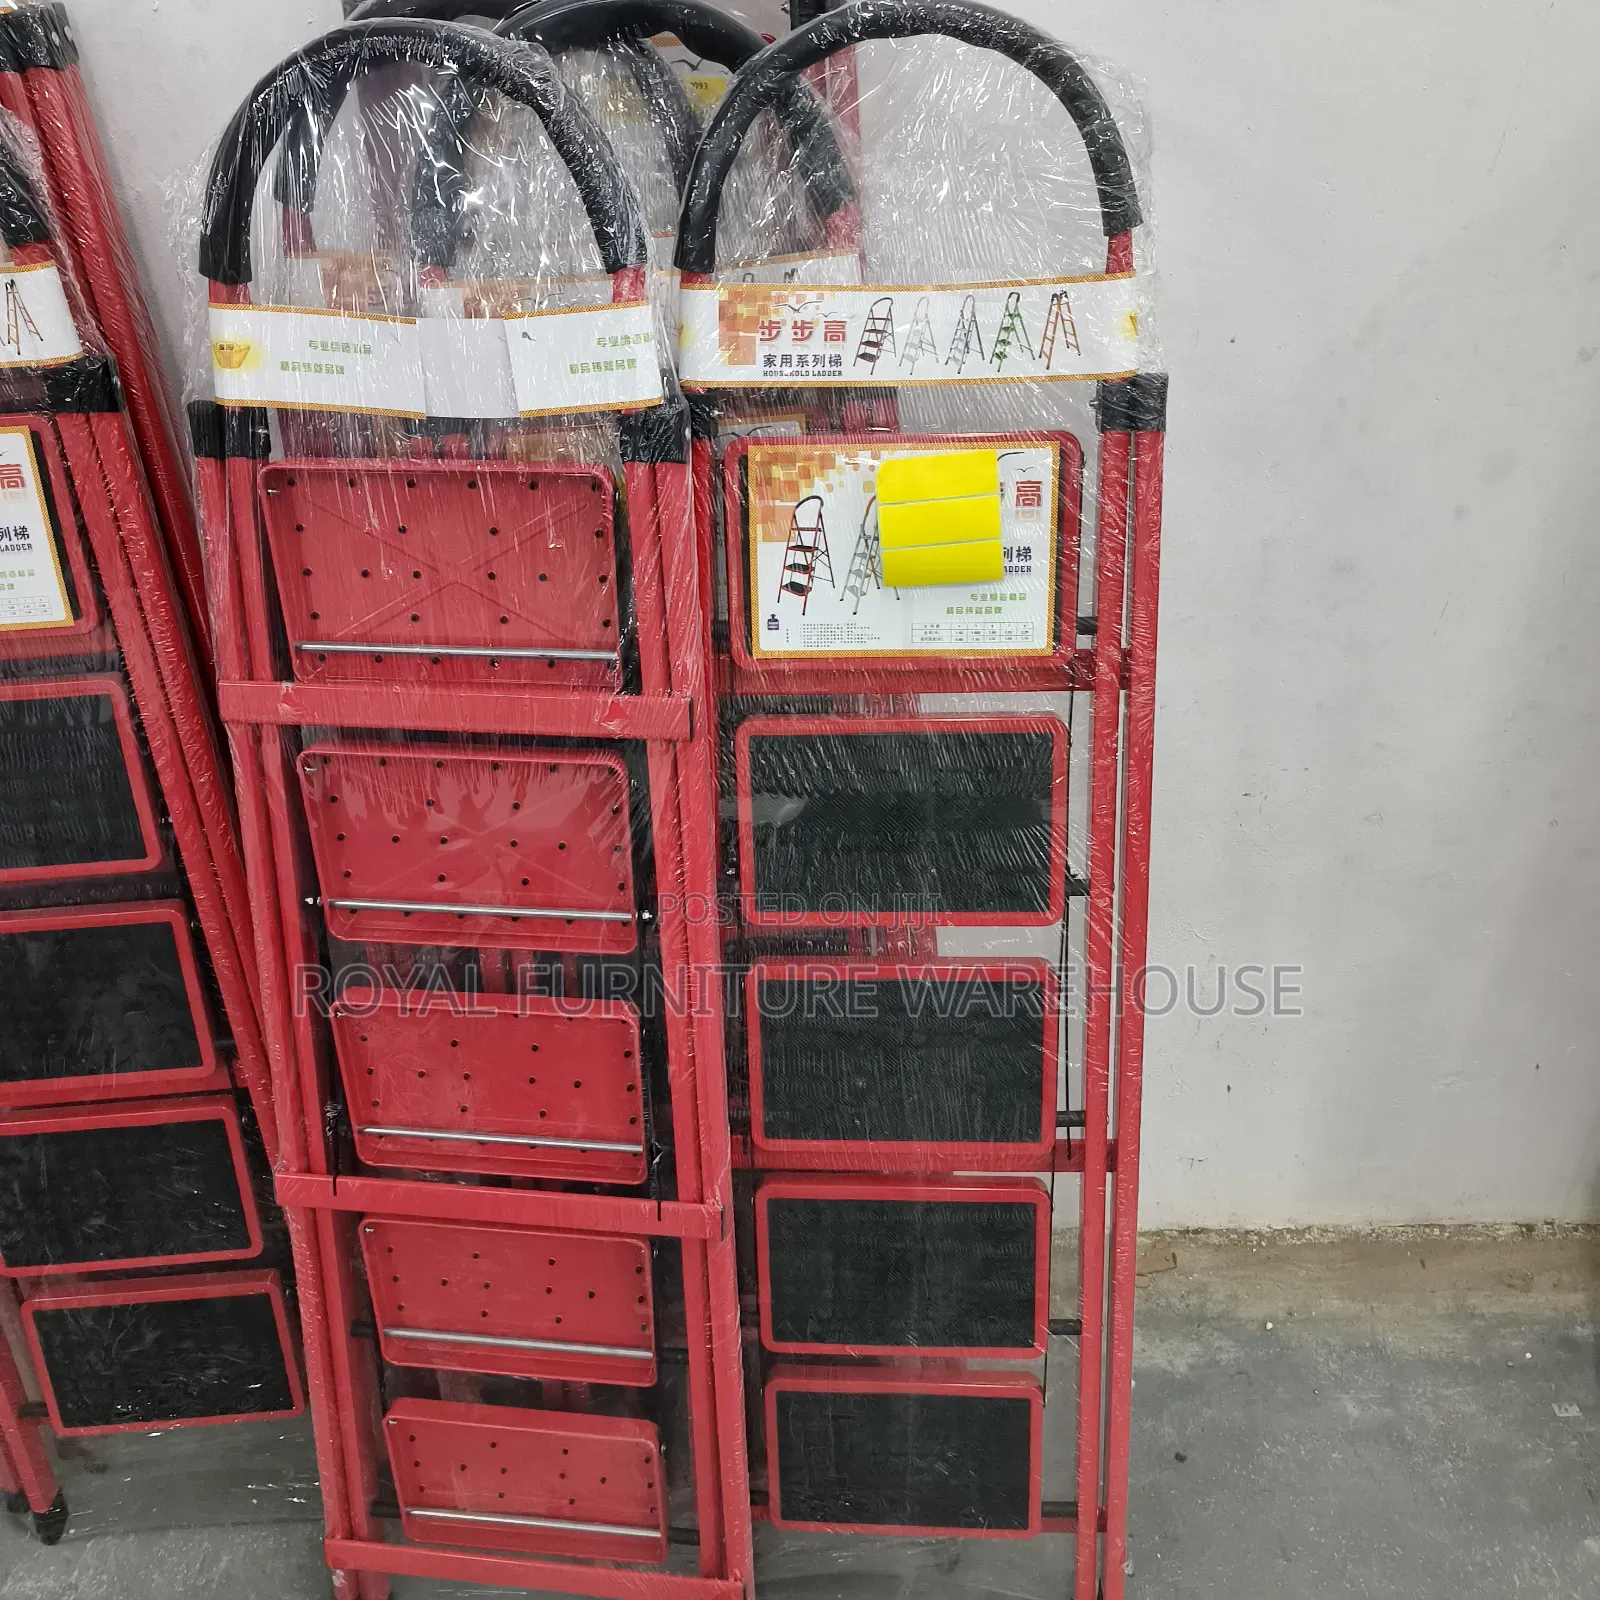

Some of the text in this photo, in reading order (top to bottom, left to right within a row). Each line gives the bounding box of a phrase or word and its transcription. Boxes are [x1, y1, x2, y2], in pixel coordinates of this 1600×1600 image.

[758, 319, 848, 342] 步步高
[763, 353, 842, 368] 家用系列梯
